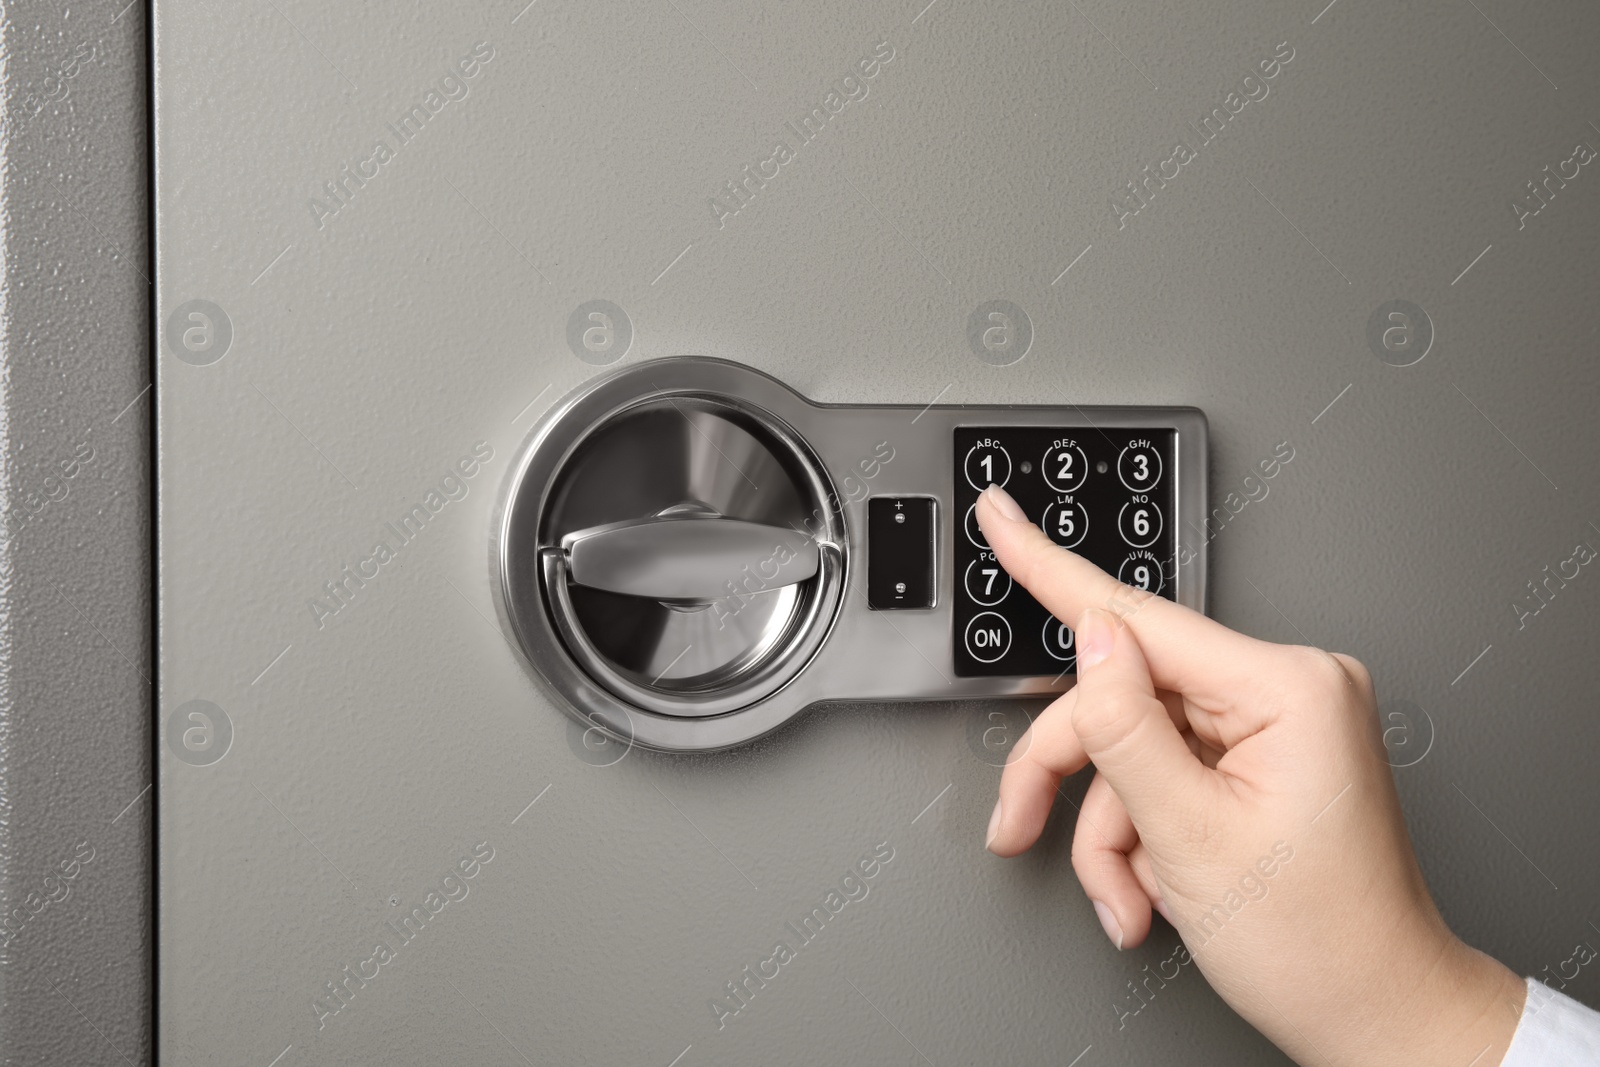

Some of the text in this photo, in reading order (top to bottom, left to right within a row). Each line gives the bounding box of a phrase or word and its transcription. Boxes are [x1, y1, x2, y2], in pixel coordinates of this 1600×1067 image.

[976, 438, 1001, 449] ABC
[1053, 438, 1077, 449] DEF
[1128, 439, 1151, 449] GHI
[980, 454, 993, 482] 1
[1056, 452, 1074, 479] 2
[1133, 454, 1149, 481] 3
[1057, 495, 1074, 505] LM
[1132, 495, 1149, 504] NO
[1058, 510, 1075, 537] 5
[1133, 509, 1150, 536] 6
[1129, 550, 1154, 561] UVW
[981, 568, 999, 595] 7
[1133, 566, 1150, 591] 9
[974, 628, 1001, 648] ON
[1057, 623, 1074, 650] 0
